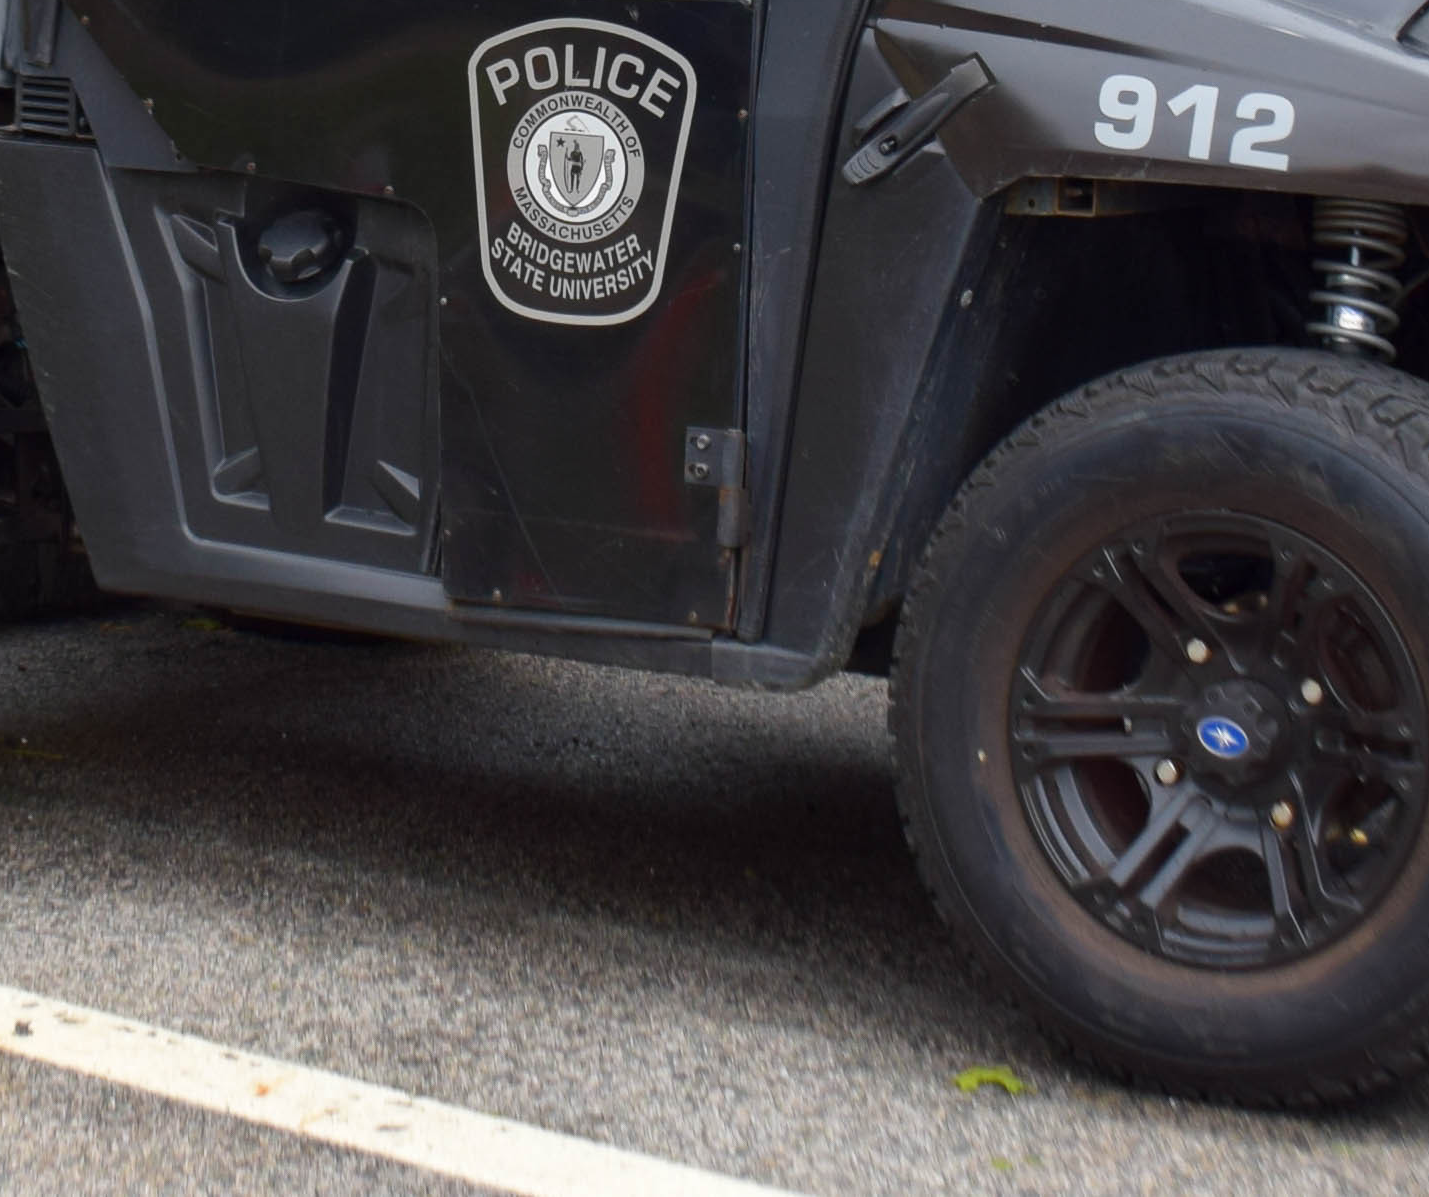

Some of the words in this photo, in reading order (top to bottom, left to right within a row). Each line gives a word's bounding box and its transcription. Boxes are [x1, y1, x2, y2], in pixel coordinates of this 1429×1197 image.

[486, 44, 681, 118] POLICE
[513, 95, 628, 149] COMMONWEALTH
[626, 136, 641, 158] OF
[1094, 74, 1295, 172] 912
[514, 187, 634, 240] MASSACHUSETTS
[492, 238, 546, 291] STATE
[550, 250, 654, 299] UNIVERSITY
[506, 222, 641, 273] BRIDGEWATER
